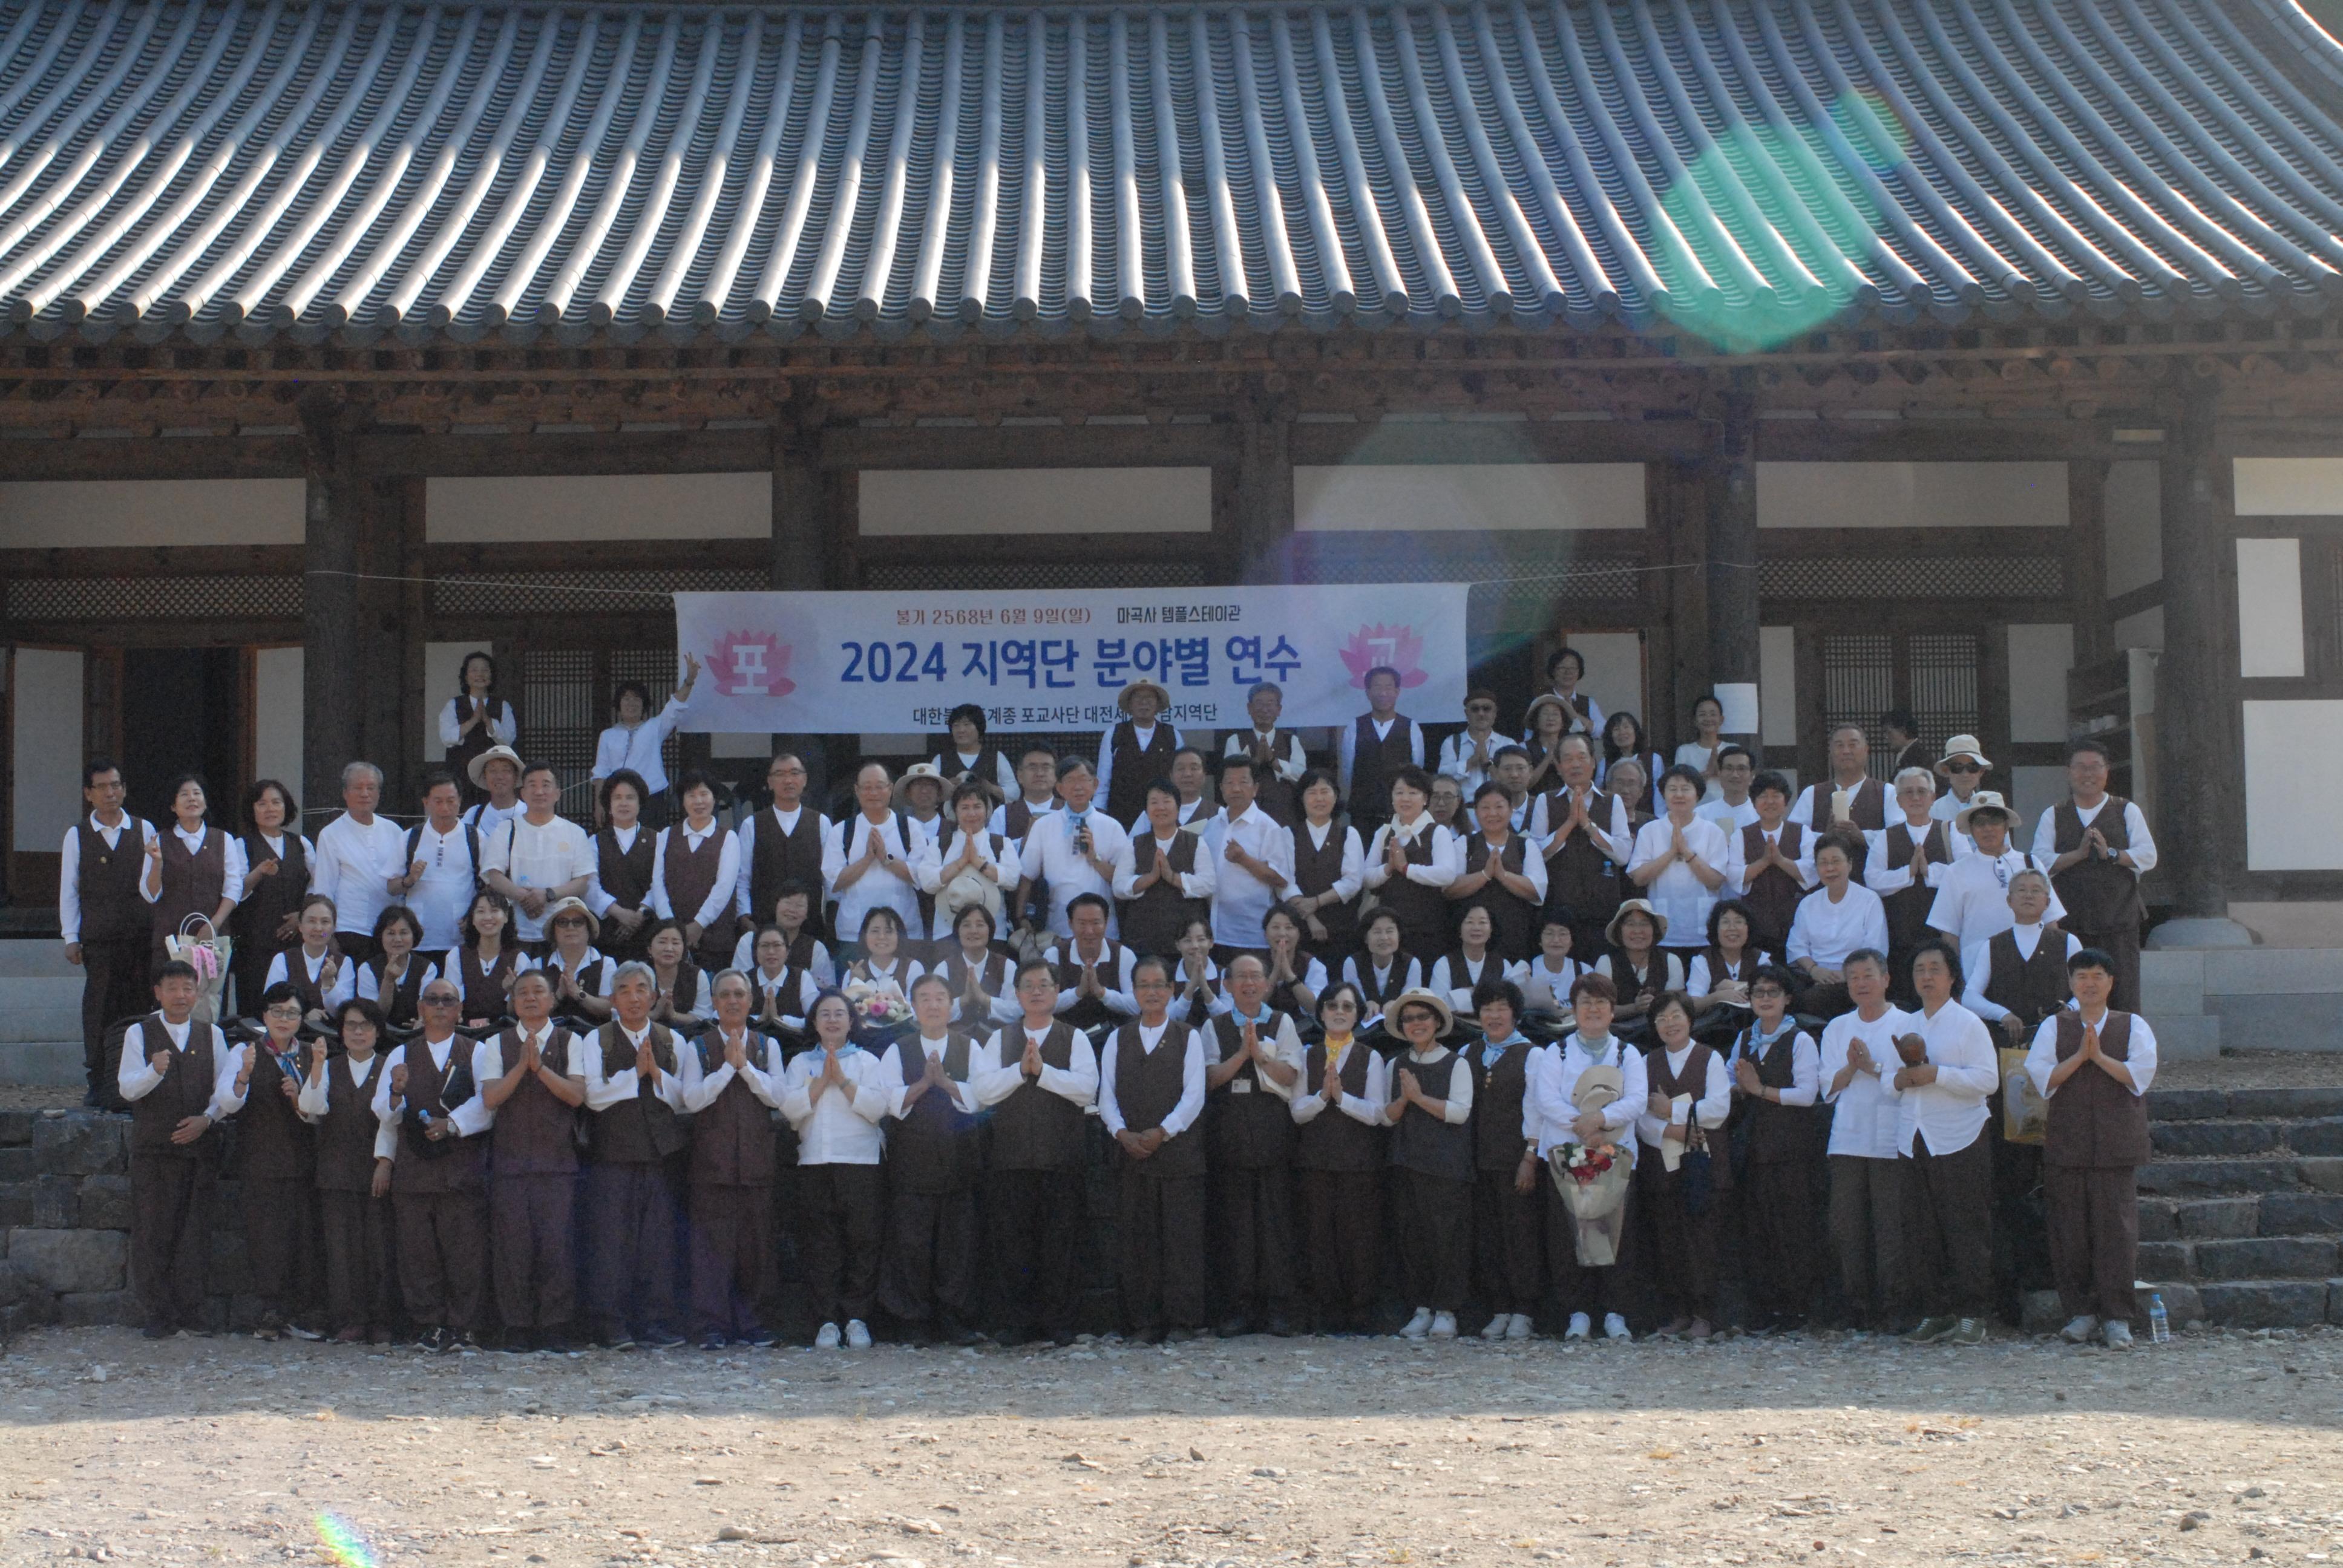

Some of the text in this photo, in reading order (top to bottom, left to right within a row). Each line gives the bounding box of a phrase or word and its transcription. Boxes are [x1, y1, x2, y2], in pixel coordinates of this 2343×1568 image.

[897, 607, 1090, 625] 불기 2568년 6월 9일(일)
[1118, 605, 1240, 623] 마곡사 템플스테이관
[731, 645, 768, 694] 포
[841, 635, 1302, 689] 2024 지역단 분야별 연수
[1021, 705, 1080, 724] 포교사단
